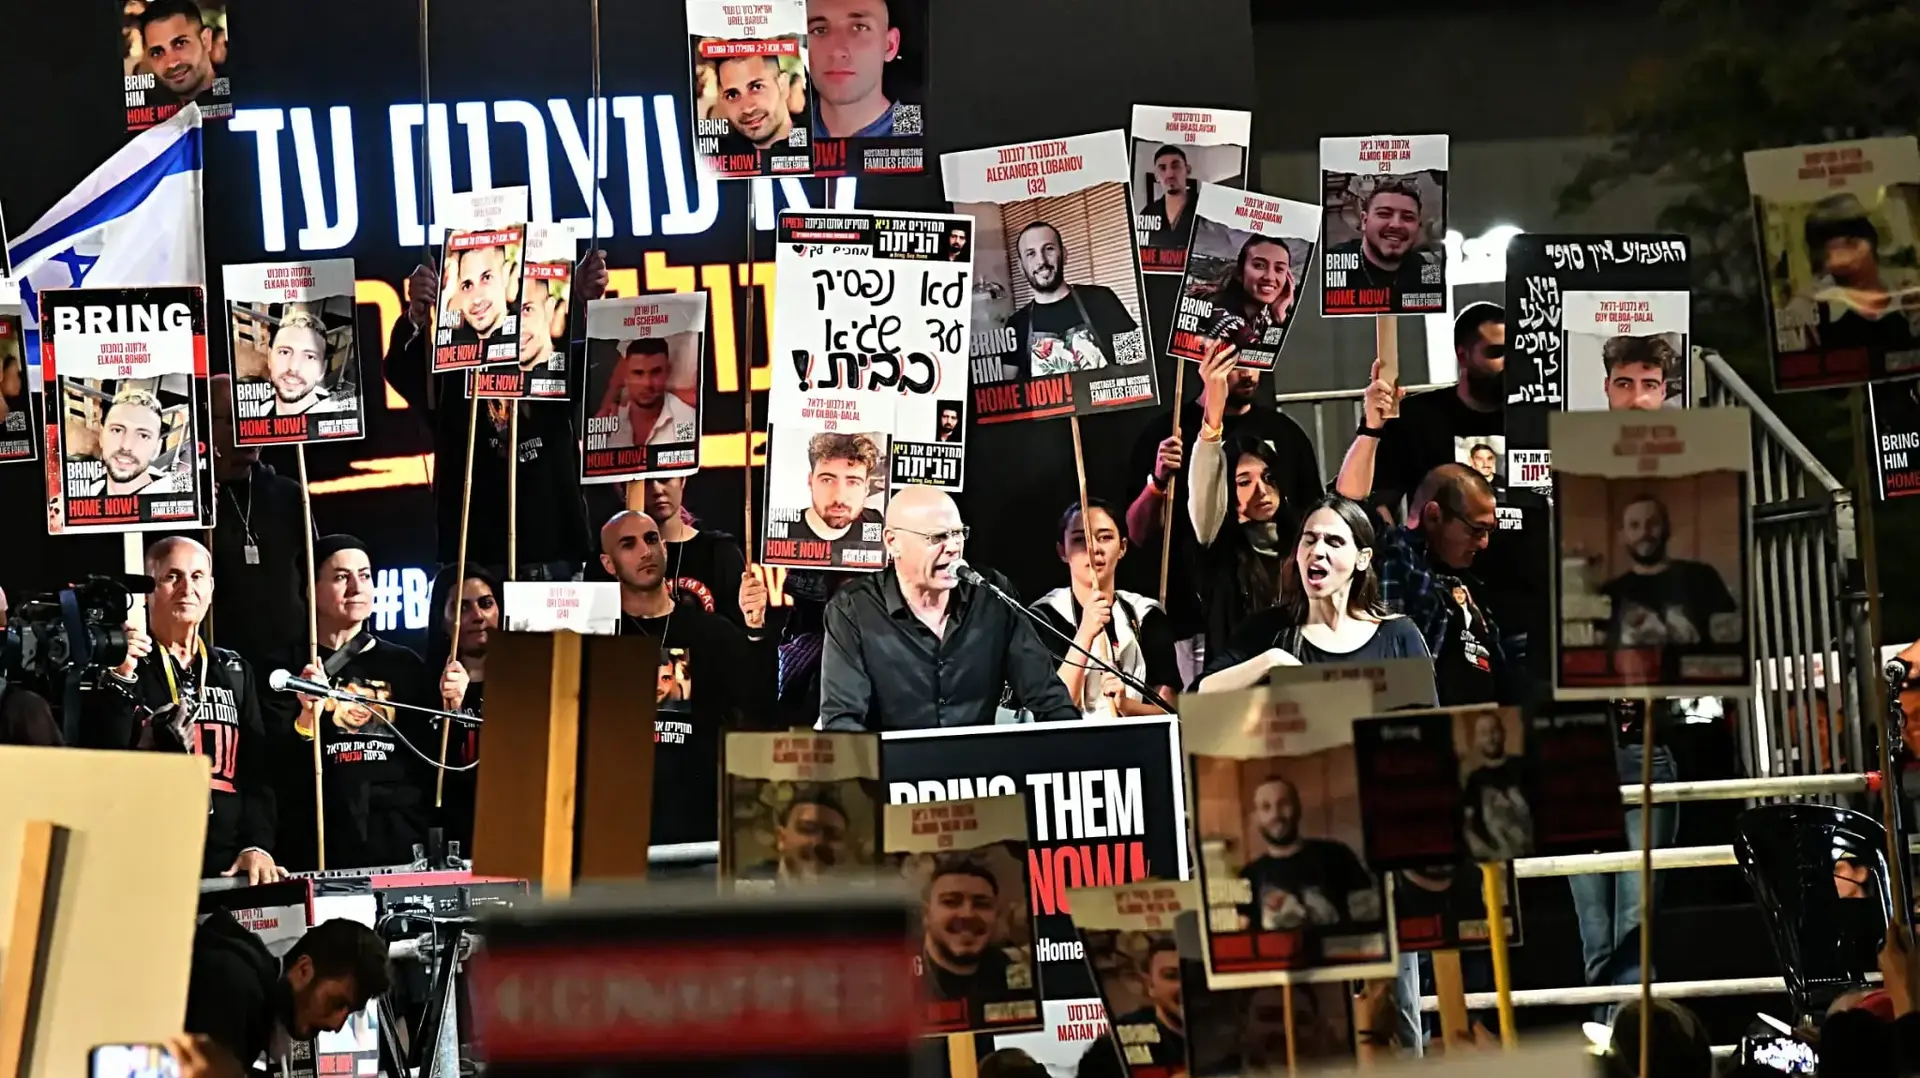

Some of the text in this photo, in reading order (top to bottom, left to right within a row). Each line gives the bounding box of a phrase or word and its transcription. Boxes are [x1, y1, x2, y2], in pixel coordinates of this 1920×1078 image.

[728, 16, 768, 25] URIEL BARUCH
[744, 26, 756, 36] (35)
[124, 73, 155, 91] BRING
[126, 91, 145, 107] HIM
[127, 106, 155, 124] HOME
[698, 119, 729, 136] BRING
[1166, 122, 1216, 133] ROM BRASLAVSKI
[698, 138, 719, 154] HIM
[1184, 132, 1196, 142] (19)
[730, 150, 761, 170] NOW!
[864, 156, 924, 170] FAMILIES FORUM
[1359, 150, 1410, 161] ALMOG MEIR JAN
[986, 155, 1083, 182] ALEXANDER LOBANOV
[1378, 162, 1391, 172] (21)
[228, 105, 359, 253] עד
[1026, 179, 1047, 194] (32)
[1235, 206, 1283, 224] NOA ARGAMANI
[892, 219, 907, 231] את
[908, 220, 945, 233] מחזירים
[1250, 220, 1264, 231] (26)
[833, 246, 870, 256] מחכים
[880, 231, 940, 254] הביתה
[1326, 253, 1359, 270] BRING
[264, 277, 316, 290] ELKANA BOHBOT
[1326, 270, 1347, 288] HIM
[284, 288, 298, 300] (34)
[812, 269, 968, 311] לא נפסיק
[1326, 286, 1390, 306] HOME NOW!
[1526, 276, 1560, 304] גיא
[1180, 296, 1213, 318] BRING
[1402, 298, 1424, 308] FAMILIES
[53, 302, 192, 335] BRING
[624, 315, 668, 326] RON SCHERMAN
[1178, 312, 1198, 332] HER
[1595, 312, 1654, 322] GUY GILBOA-DALAL
[437, 329, 452, 345] HIM
[640, 326, 652, 336] (19)
[926, 319, 965, 354] עד
[1617, 322, 1631, 334] (22)
[970, 326, 1017, 357] BRING
[1174, 332, 1202, 352] HOME
[97, 353, 152, 365] ELKANA BOHBOT
[436, 344, 456, 363] HOME
[457, 340, 483, 361] NOW!
[118, 366, 132, 376] (34)
[971, 356, 1003, 384] HIM
[496, 371, 524, 390] NOW!
[1089, 375, 1150, 391] HOSTAGES AND MISSING
[237, 382, 271, 402] BRING
[975, 374, 1072, 414] HOME NOW!
[1091, 384, 1152, 403] FAMILIES FORUM
[1507, 382, 1562, 405] בבית
[238, 400, 260, 418] HIM
[802, 408, 860, 422] GUY GILBOA-DALAL
[240, 414, 308, 436] HOME NOW!
[588, 416, 619, 434] BRING
[824, 420, 837, 430] (22)
[588, 434, 608, 450] HIM
[910, 444, 924, 456] את
[1881, 432, 1920, 452] BRING
[586, 446, 647, 468] HOME NOW!
[926, 446, 962, 458] מחזירים
[1884, 452, 1908, 470] HIM
[66, 462, 102, 480] BRING
[897, 456, 956, 480] הביתה
[68, 480, 91, 497] HIM
[68, 499, 102, 518] HOME
[104, 495, 140, 516] NOW!
[768, 522, 788, 539] HIM
[766, 540, 797, 558] HOME
[800, 541, 832, 559] NOW!
[1026, 768, 1146, 842] THEM
[252, 918, 278, 930] BERMAN
[1057, 1024, 1094, 1042] MATAN
